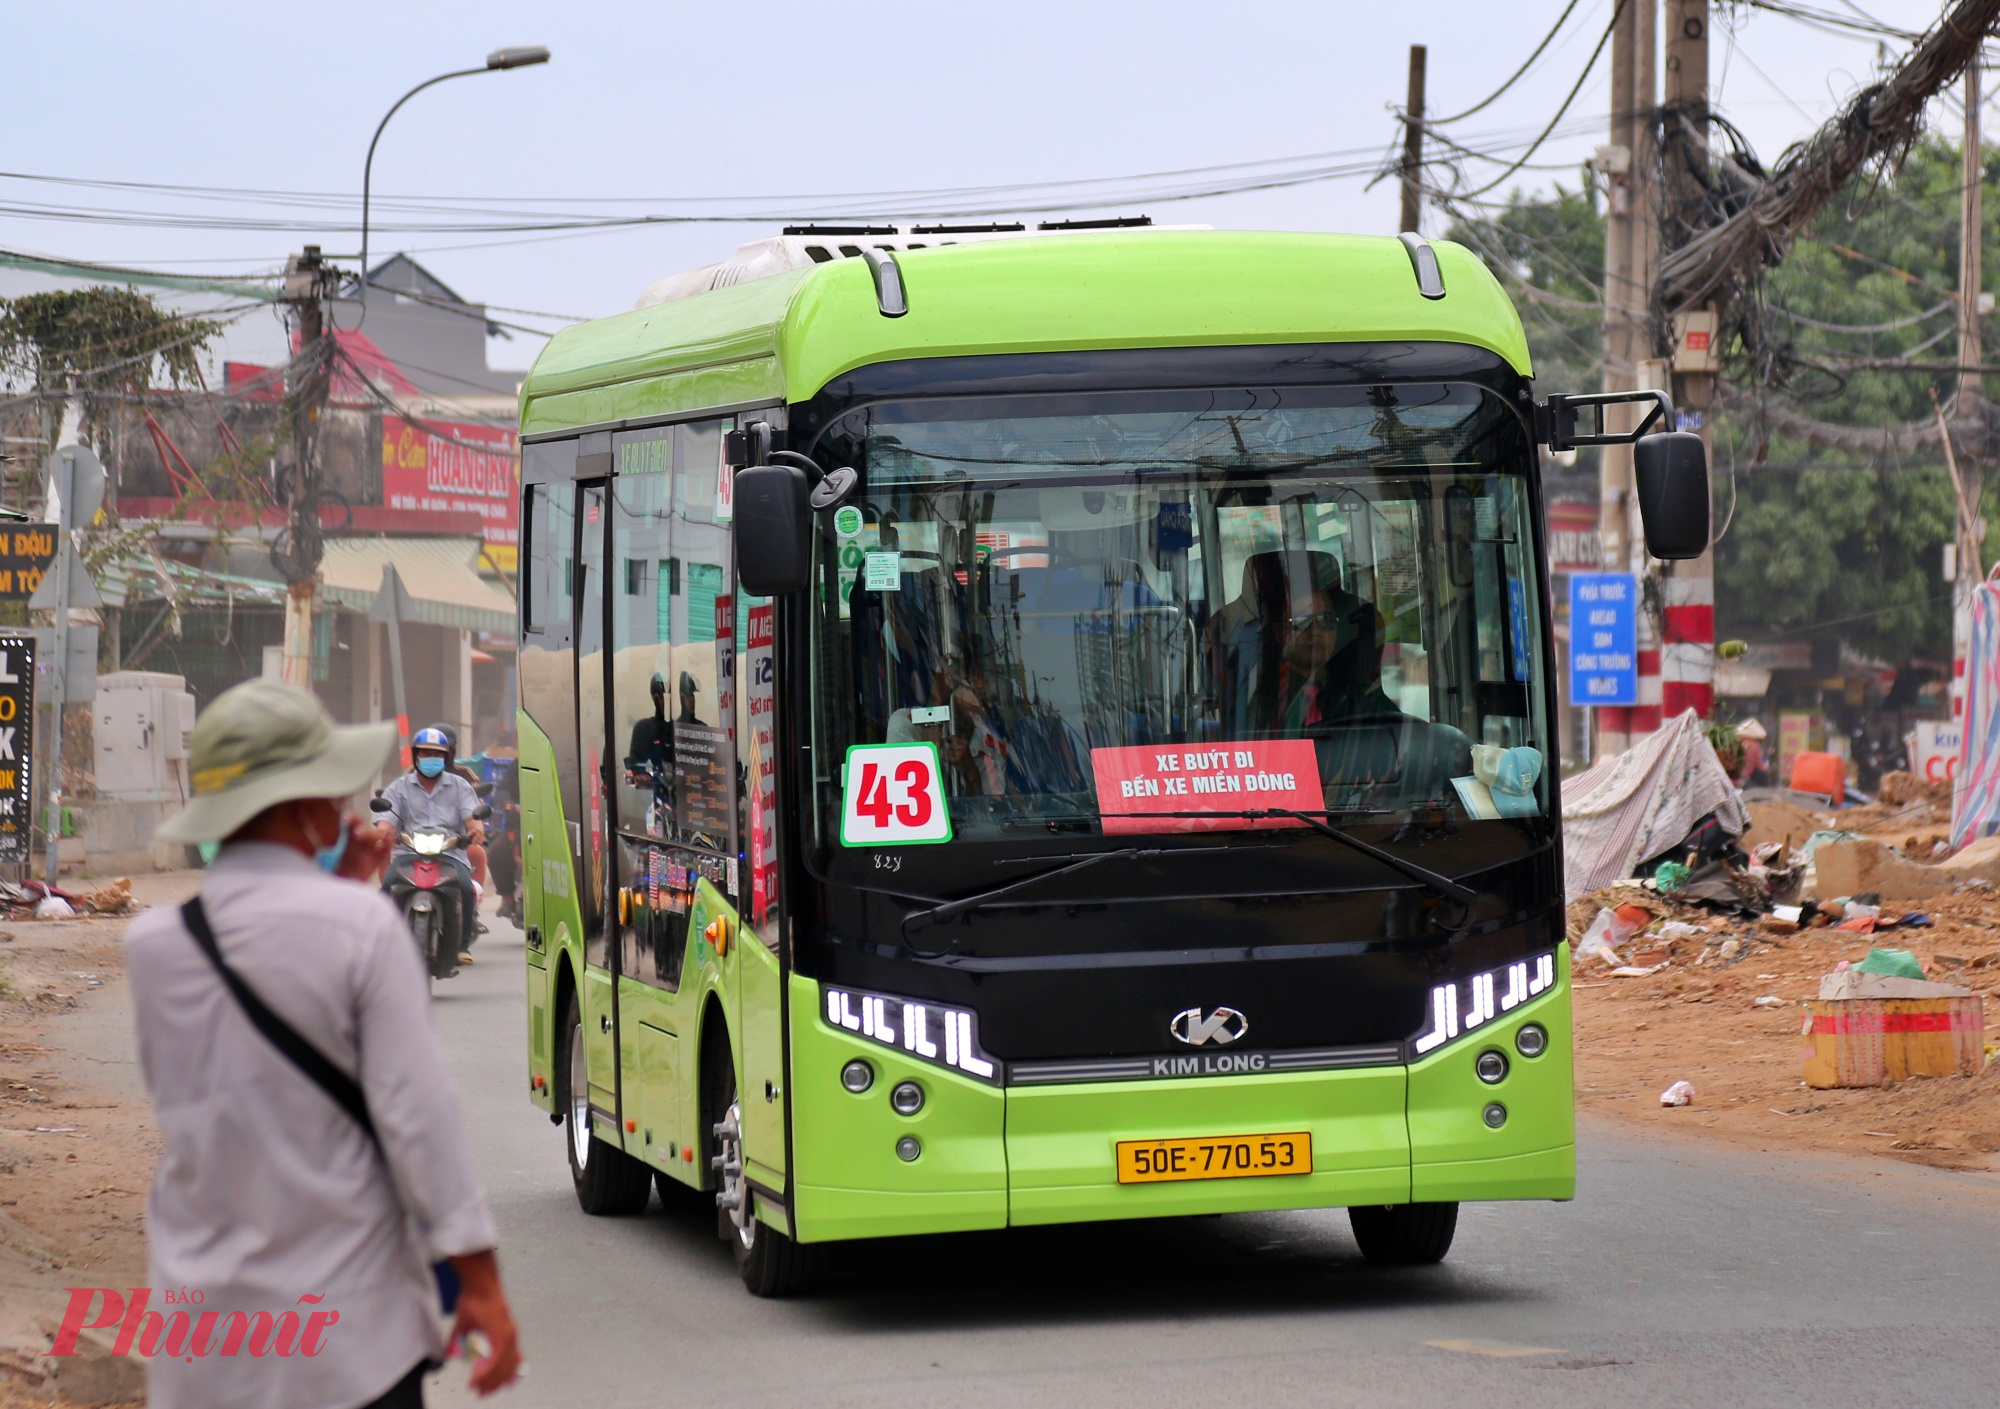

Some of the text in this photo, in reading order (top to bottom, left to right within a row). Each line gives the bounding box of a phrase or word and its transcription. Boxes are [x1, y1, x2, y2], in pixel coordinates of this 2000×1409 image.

[14, 529, 52, 561] ĐẬU
[1588, 678, 1618, 696] WORKS
[1155, 749, 1254, 772] XE BUÝT ĐI
[856, 760, 932, 828] 43
[1120, 770, 1296, 798] BẾN XE MIỀN ĐÔNG
[1153, 1054, 1266, 1076] KIM LONG
[1134, 1141, 1295, 1175] 50E-770.53
